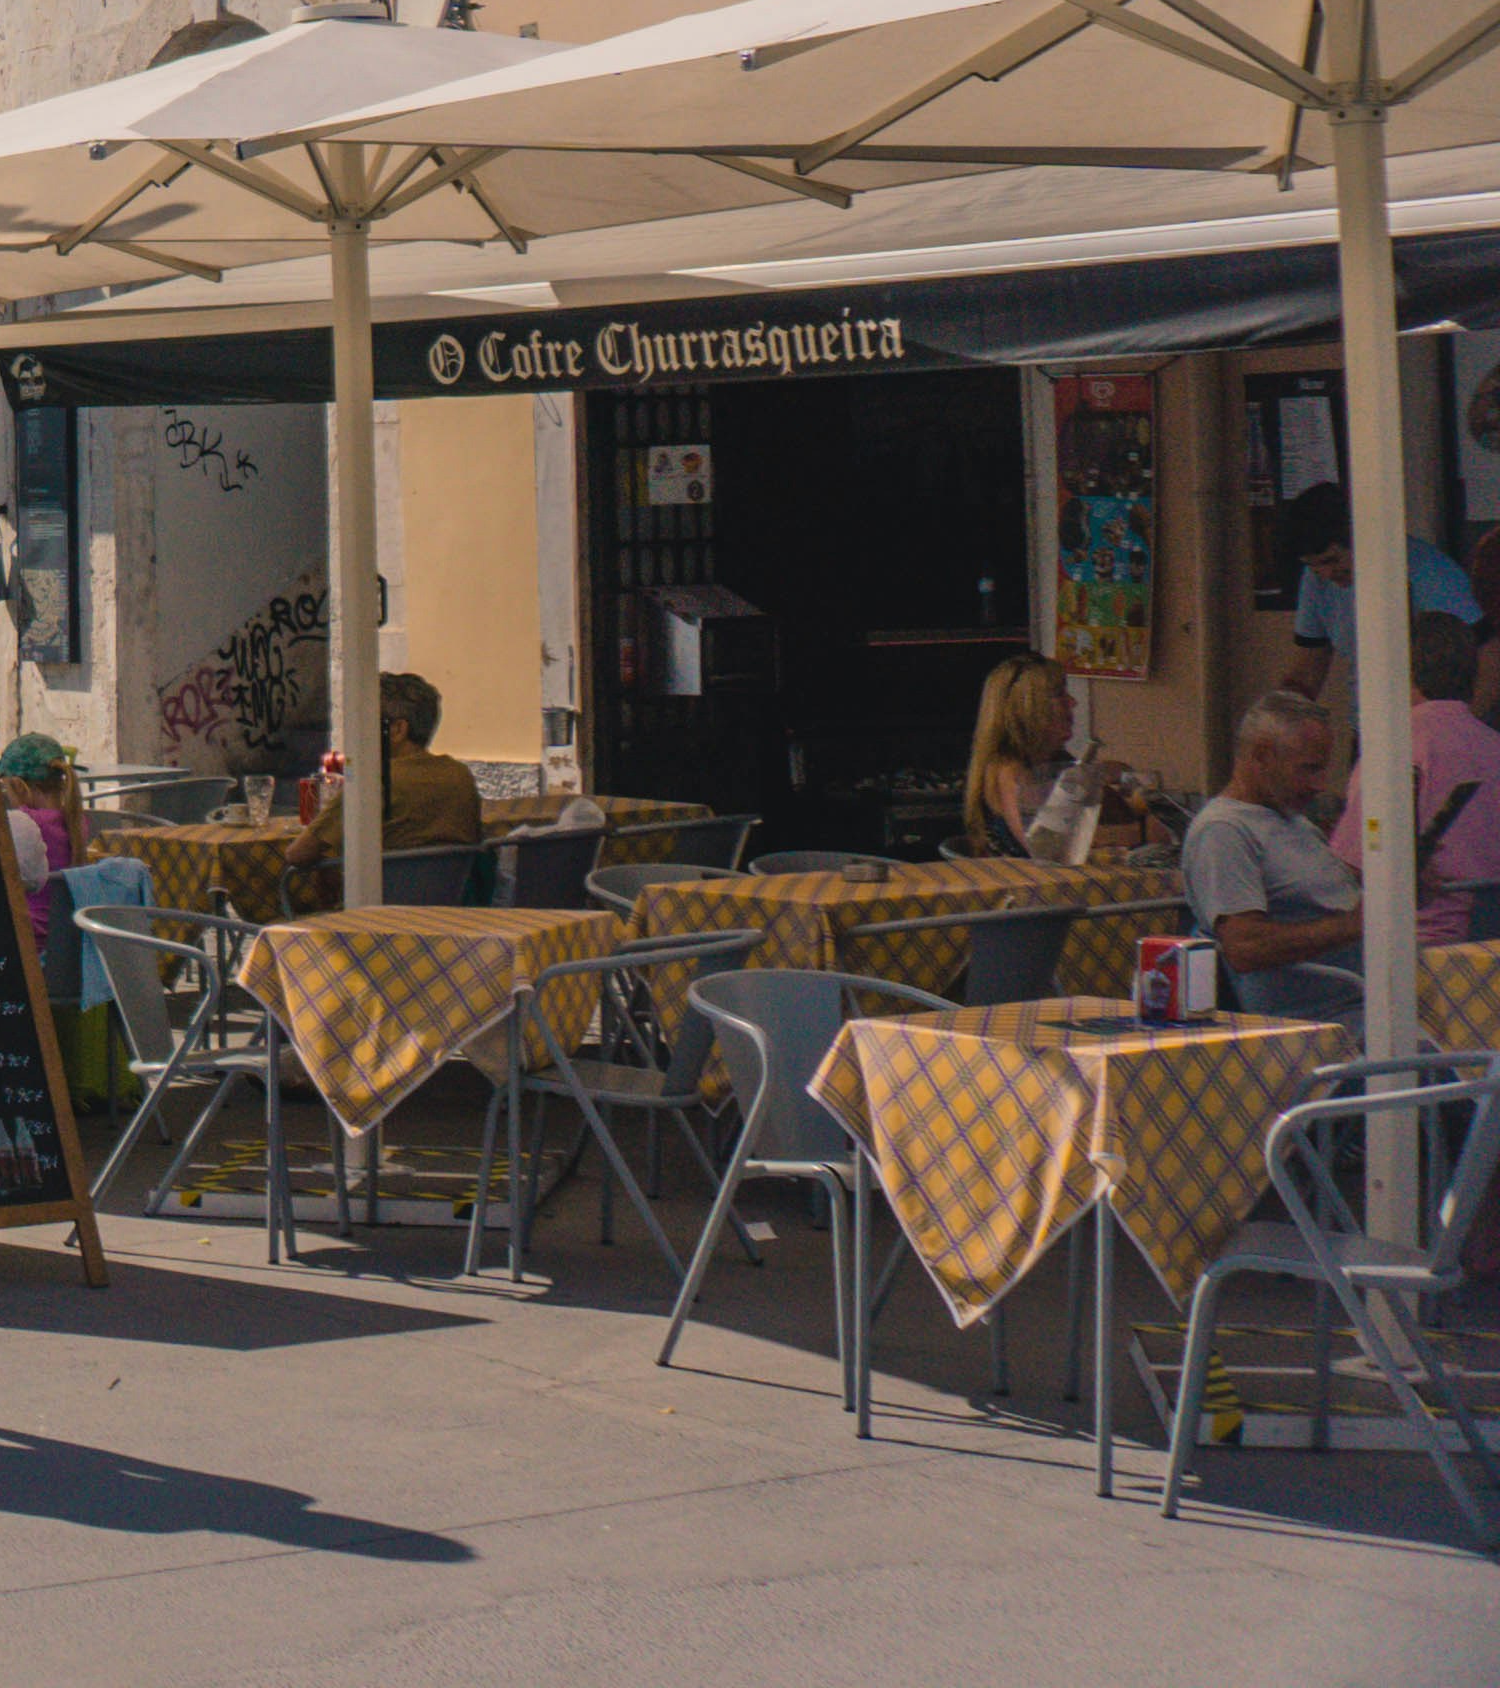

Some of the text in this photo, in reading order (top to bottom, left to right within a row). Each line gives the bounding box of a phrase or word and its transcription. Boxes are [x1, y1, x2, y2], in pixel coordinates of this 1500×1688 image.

[428, 307, 907, 385] O Cofre Churrasqueira
